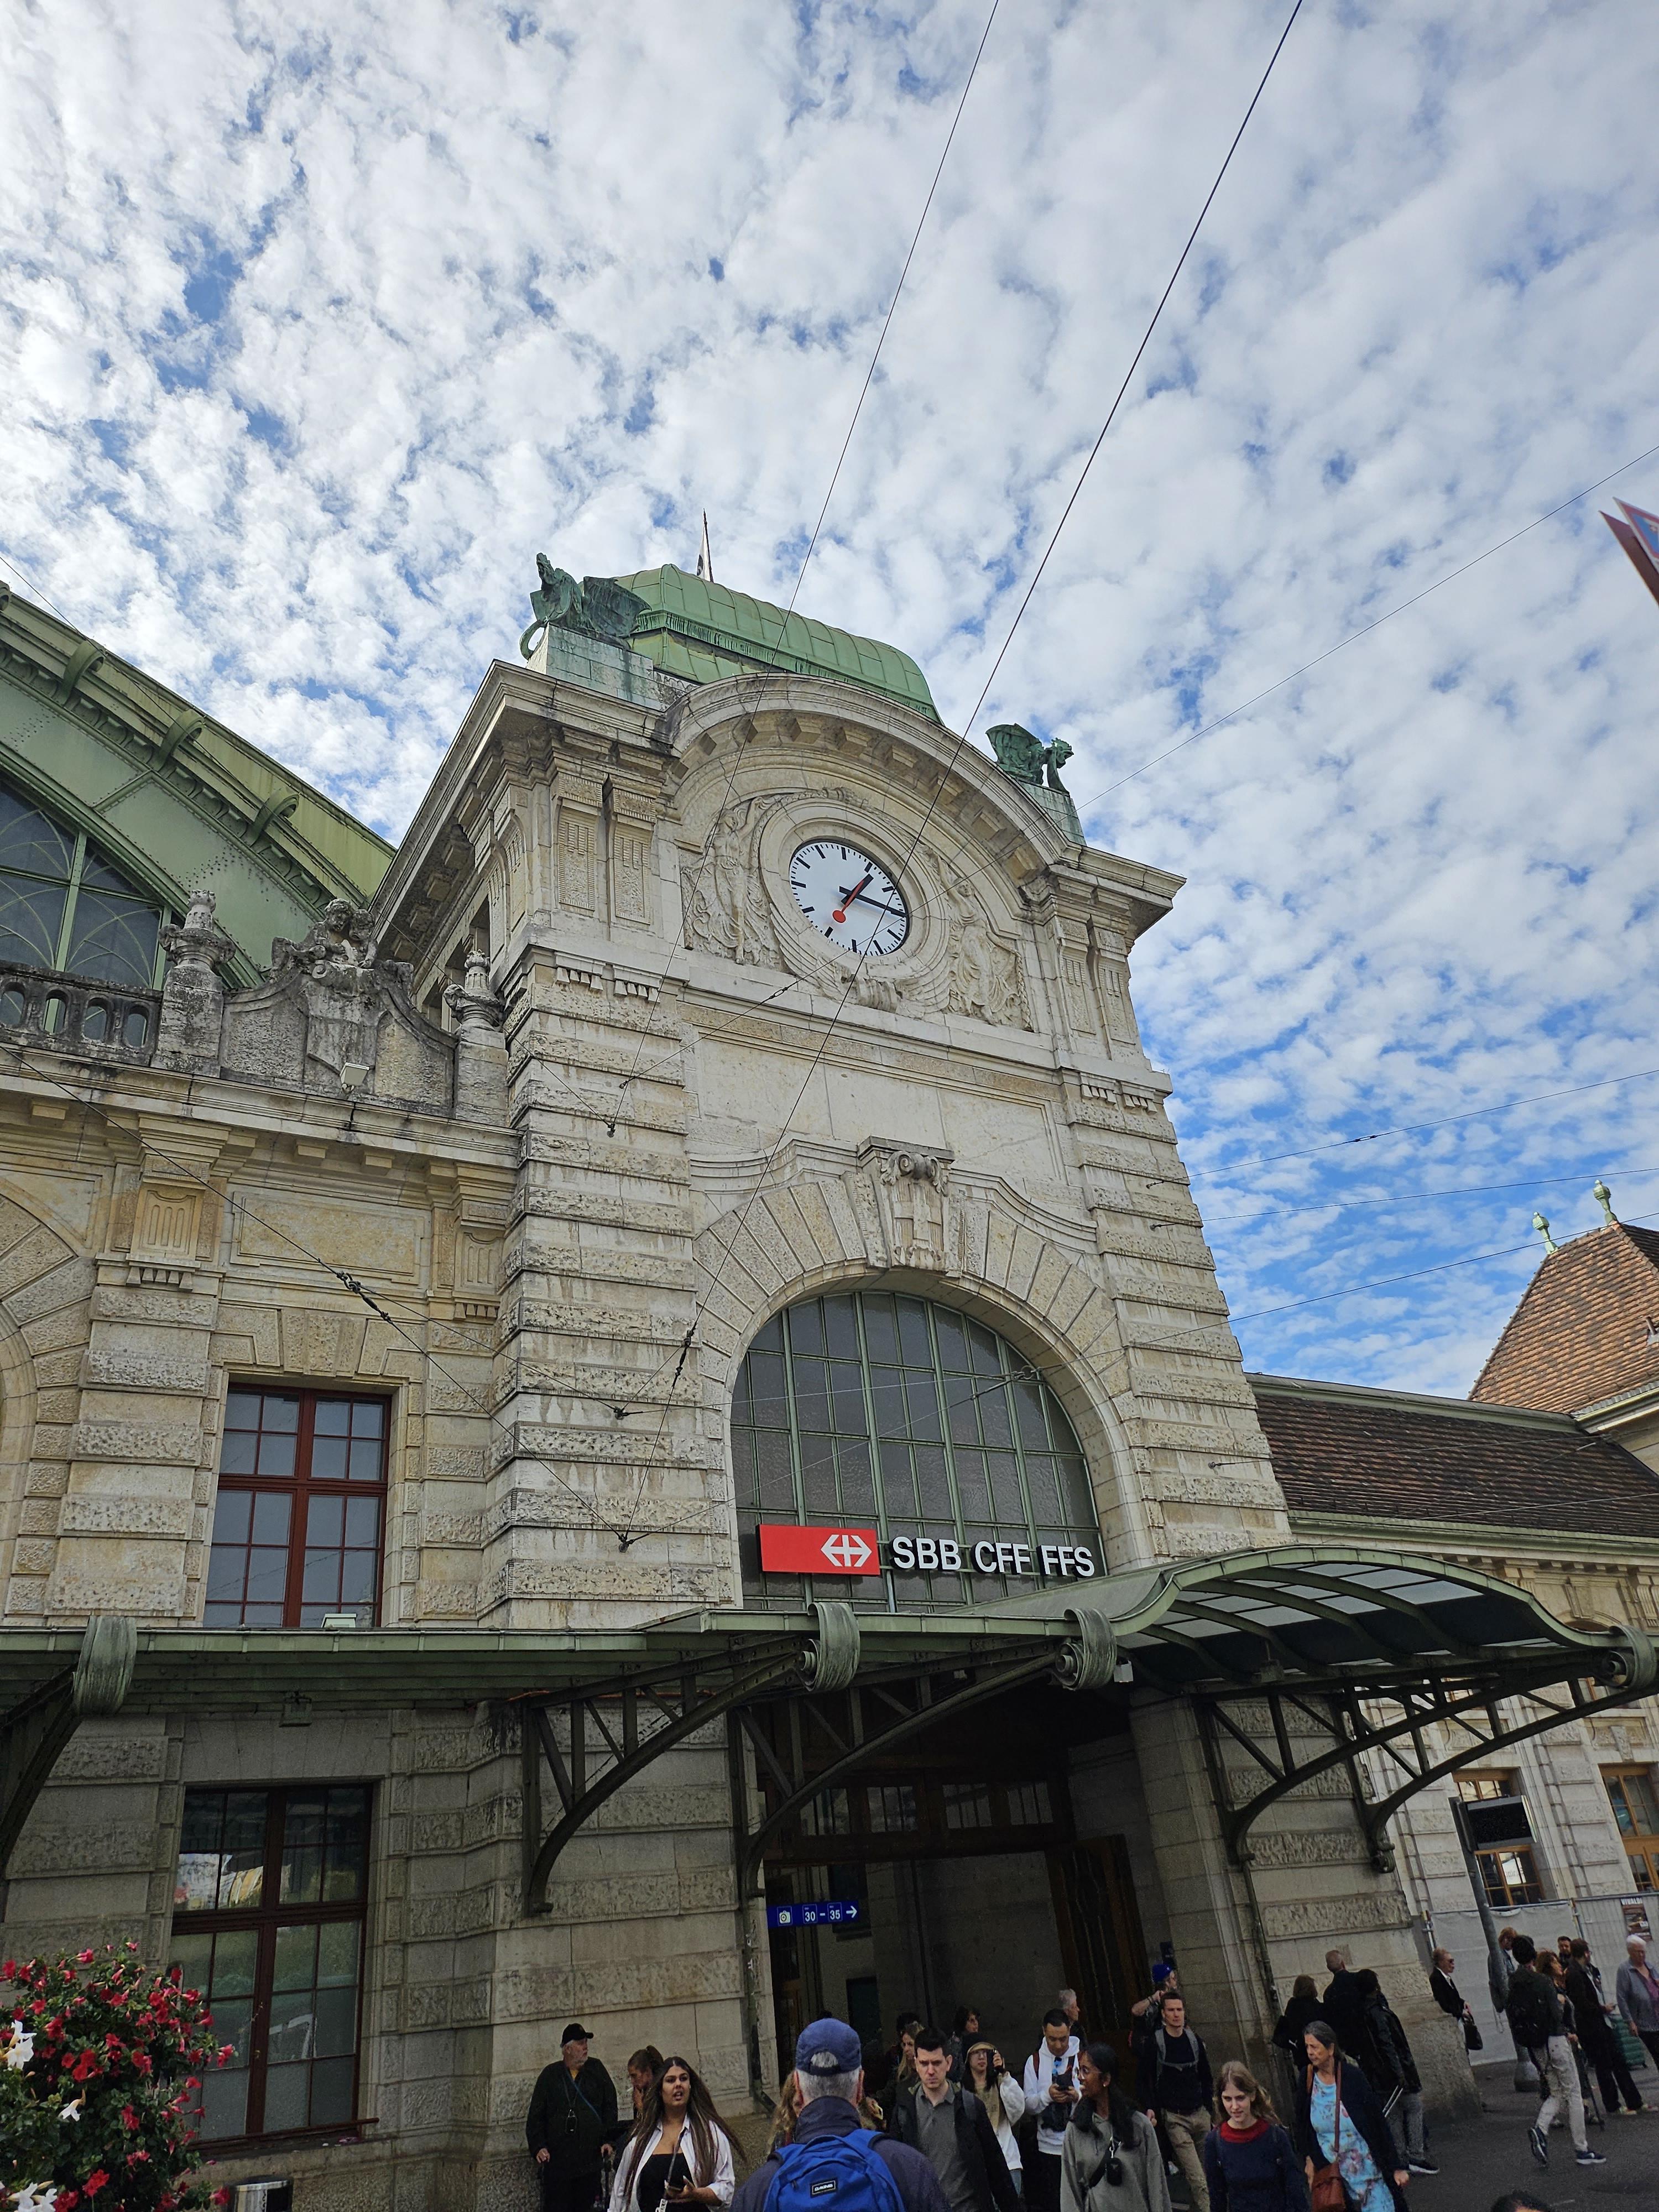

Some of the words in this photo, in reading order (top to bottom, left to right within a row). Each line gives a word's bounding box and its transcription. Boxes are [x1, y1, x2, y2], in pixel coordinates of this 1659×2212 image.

[892, 1536, 962, 1571] SBB
[974, 1541, 1031, 1574] CFF
[1040, 1545, 1095, 1578] FFS
[805, 1911, 816, 1922] 30
[830, 1910, 841, 1920] 35
